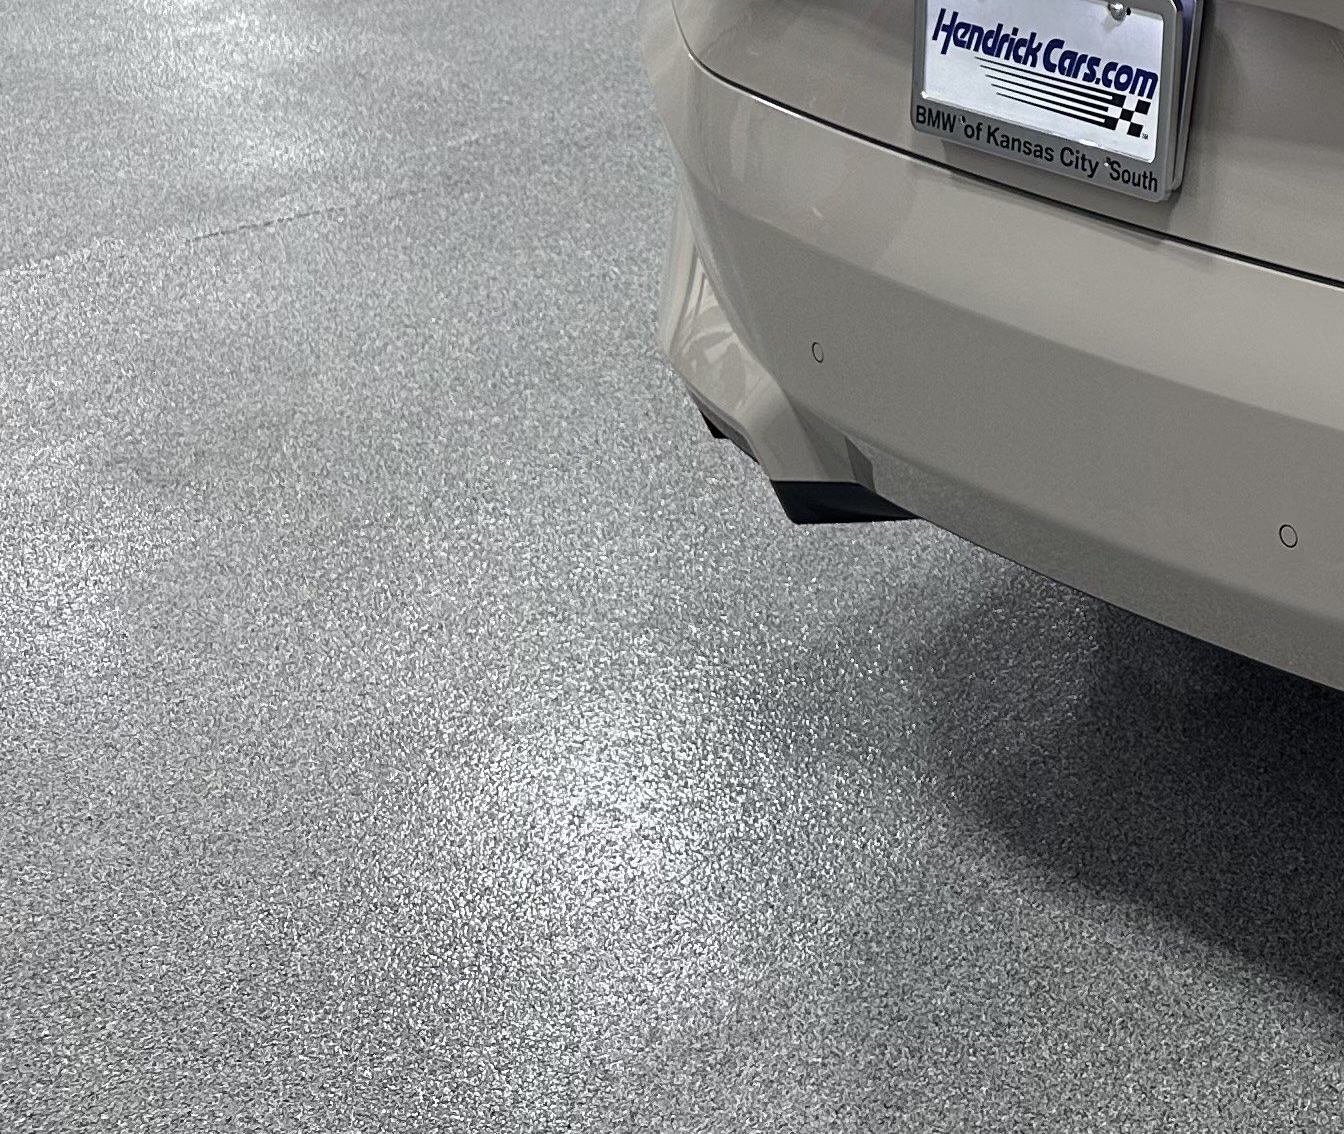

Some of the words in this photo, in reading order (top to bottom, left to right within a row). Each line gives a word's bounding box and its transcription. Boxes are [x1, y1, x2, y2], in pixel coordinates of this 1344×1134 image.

[915, 105, 957, 134] BMW
[964, 120, 984, 141] of
[986, 127, 1055, 163] Kansas
[1059, 145, 1099, 178] City
[1109, 159, 1159, 193] South
